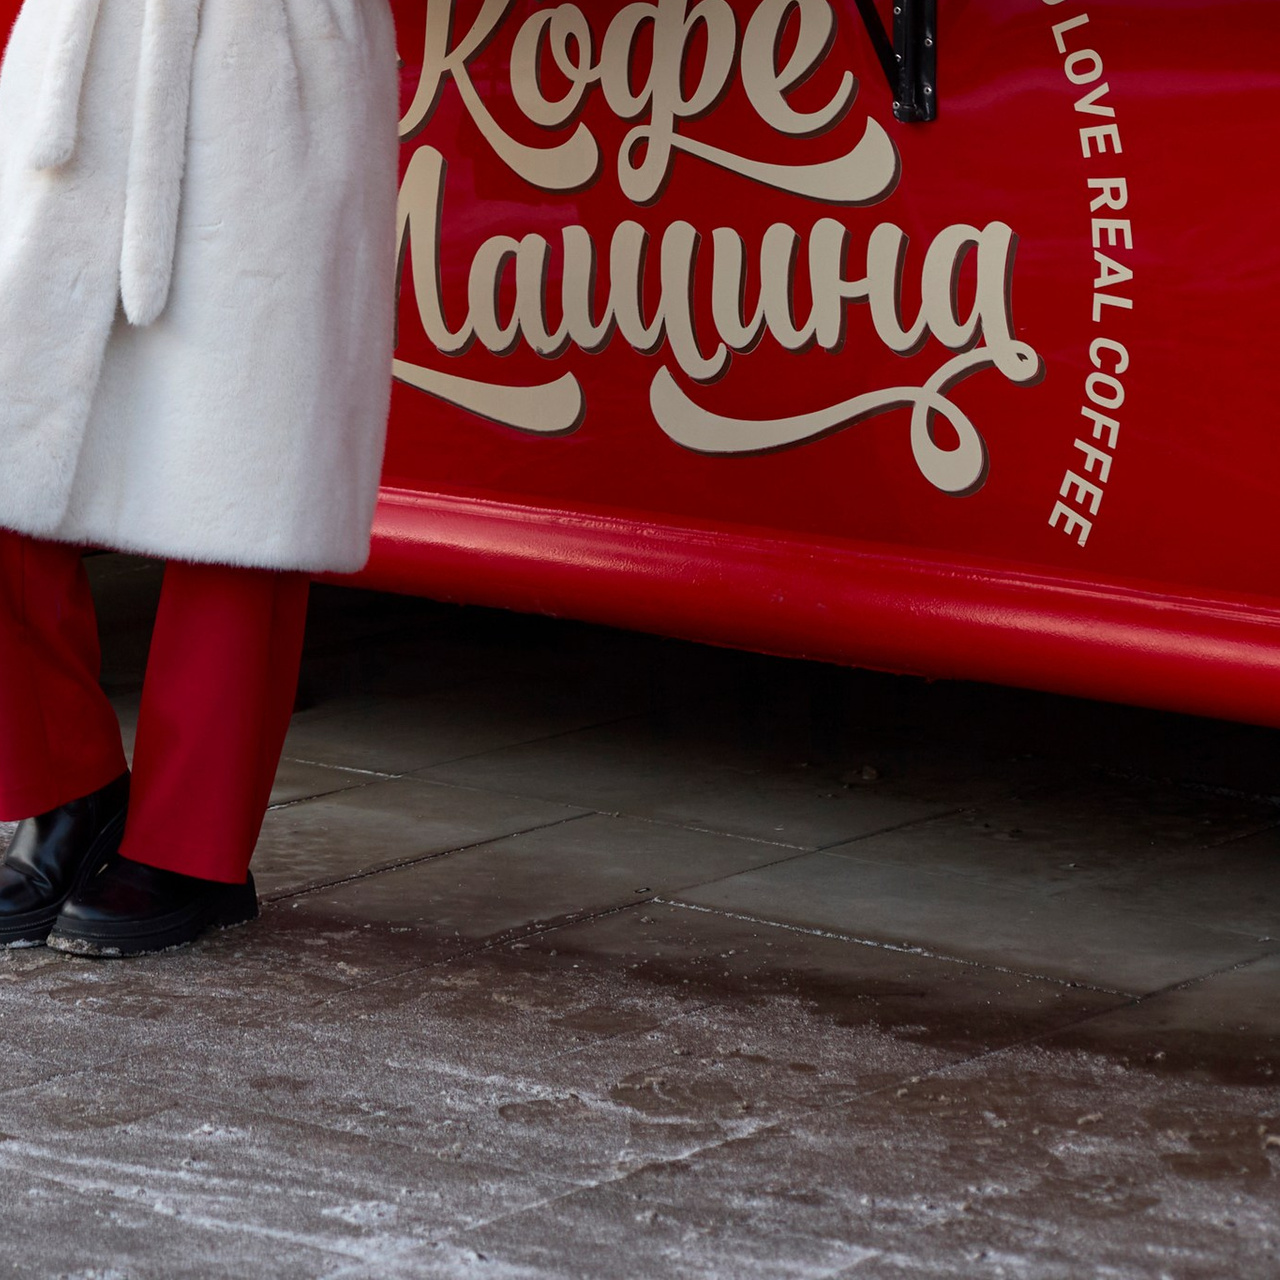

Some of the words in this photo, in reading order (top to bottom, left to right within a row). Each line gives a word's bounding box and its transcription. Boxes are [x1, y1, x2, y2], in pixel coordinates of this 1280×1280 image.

[1050, 12, 1125, 159] LOVE
[1085, 175, 1134, 324] REAL
[1048, 337, 1131, 548] COFFEE
